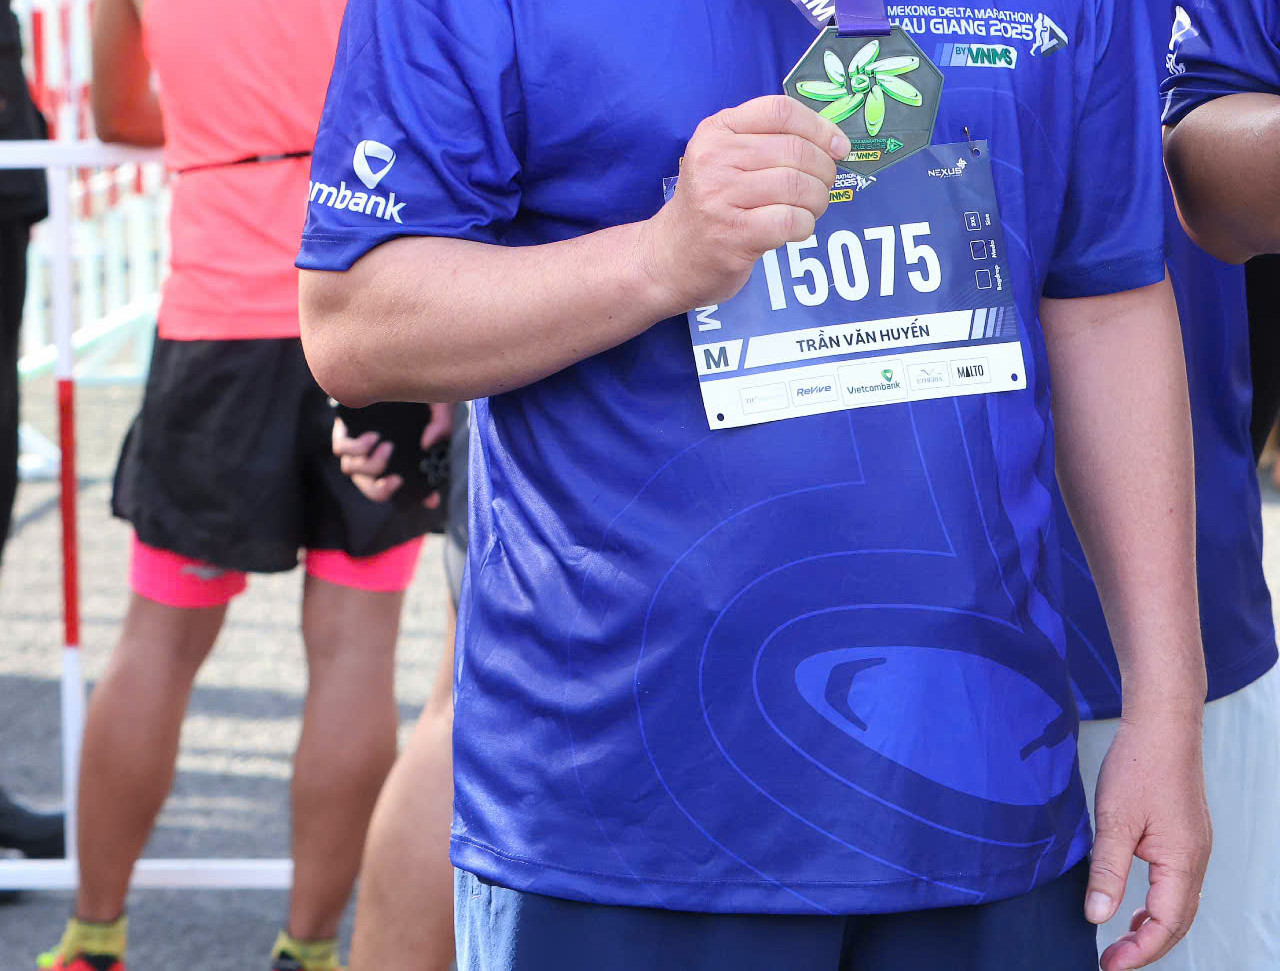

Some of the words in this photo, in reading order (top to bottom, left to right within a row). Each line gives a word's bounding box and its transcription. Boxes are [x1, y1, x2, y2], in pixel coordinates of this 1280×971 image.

[887, 5, 936, 17] MEKONG
[938, 7, 974, 18] DELTA
[974, 8, 1034, 23] MARATHON
[929, 18, 987, 36] GIANG
[989, 20, 1035, 41] 2025
[955, 46, 967, 55] BY
[967, 46, 1013, 66] VNMS
[928, 167, 962, 179] NEXUS
[835, 178, 857, 188] 2025
[762, 221, 942, 311] 15075
[796, 329, 840, 353] TRẦN
[843, 326, 878, 347] VĂN
[880, 318, 931, 343] HUYẾN
[704, 346, 730, 370] M
[957, 364, 984, 379] MALTO
[796, 383, 832, 397] ReVive
[847, 379, 901, 396] Vietcombank
